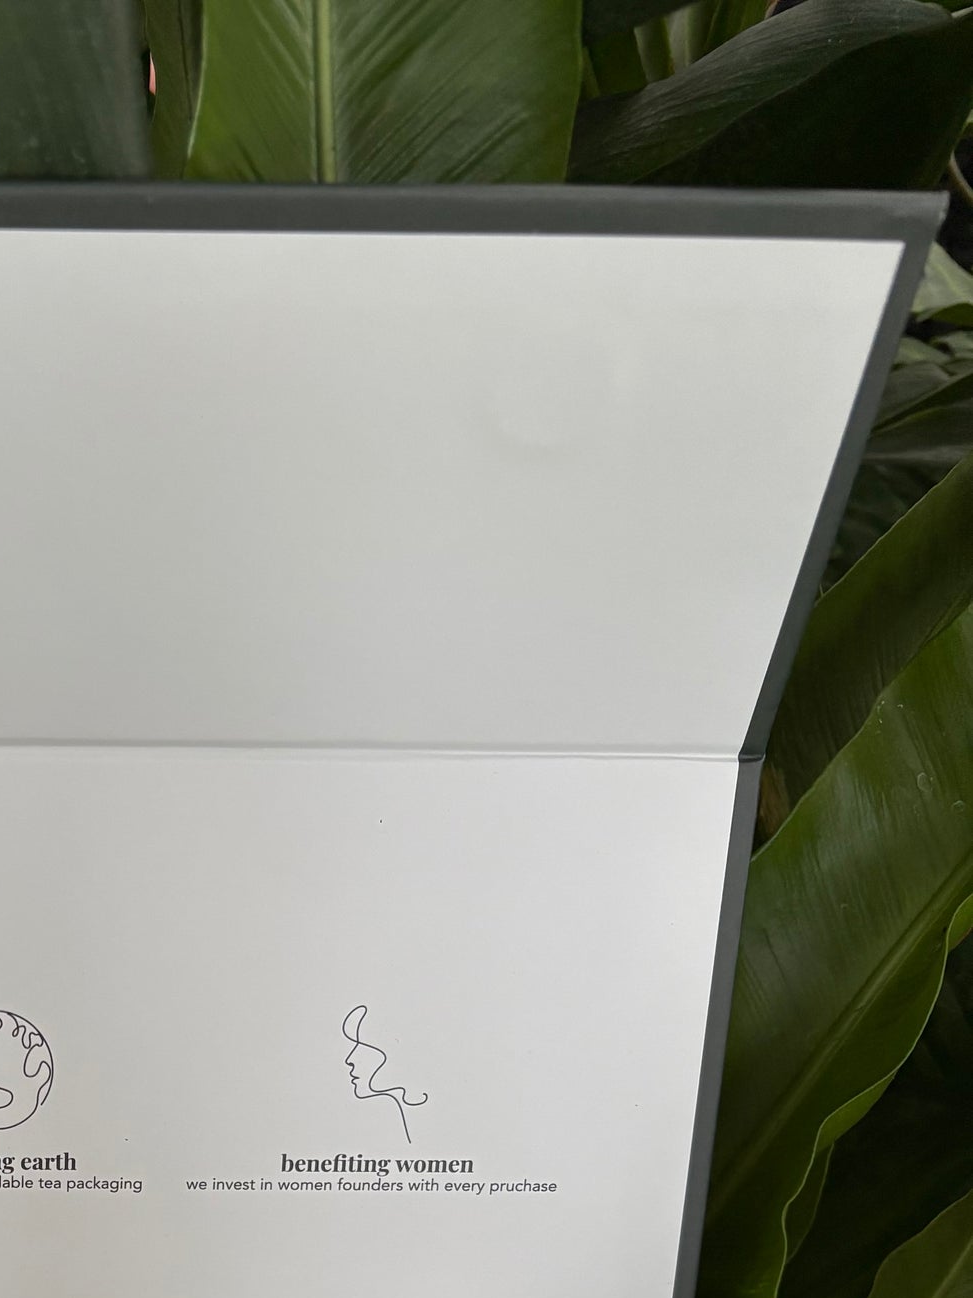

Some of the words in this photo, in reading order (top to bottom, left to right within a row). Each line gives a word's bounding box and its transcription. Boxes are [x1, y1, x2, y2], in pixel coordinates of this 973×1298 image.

[20, 1152, 77, 1171] earth
[281, 1153, 391, 1177] benefiting
[396, 1158, 474, 1174] women
[38, 1177, 62, 1189] tea
[66, 1177, 143, 1192] packaging
[186, 1180, 207, 1191] we
[212, 1178, 256, 1191] invest
[260, 1178, 273, 1191] in
[278, 1180, 332, 1192] women
[337, 1178, 403, 1192] founders
[408, 1178, 439, 1192] with
[444, 1181, 484, 1195] every
[489, 1179, 558, 1195] pruchase
